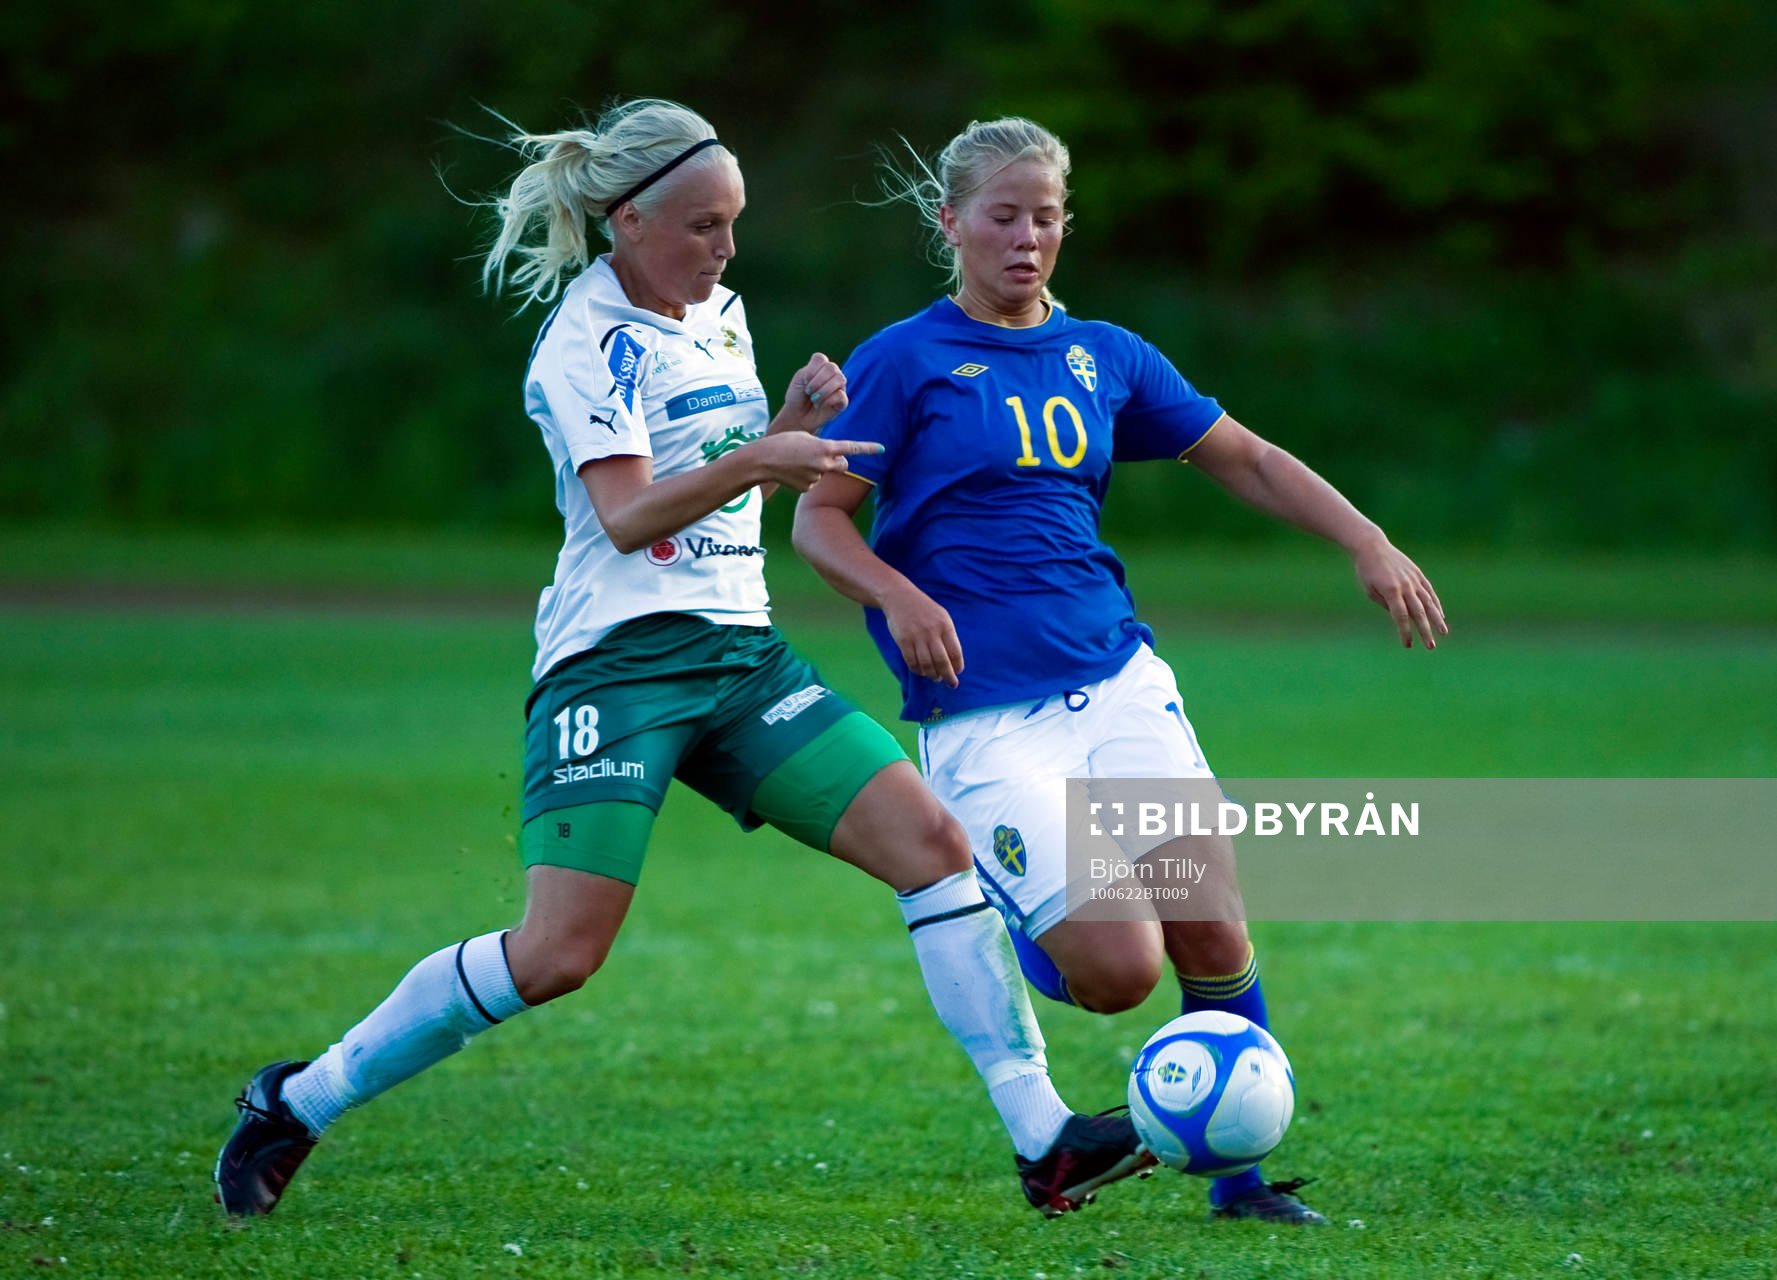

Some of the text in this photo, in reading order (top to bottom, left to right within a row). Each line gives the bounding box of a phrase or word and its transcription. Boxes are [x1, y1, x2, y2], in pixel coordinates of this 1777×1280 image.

[686, 391, 734, 410] Danica
[1005, 396, 1088, 468] 10
[553, 705, 599, 760] 18
[553, 758, 645, 784] stadium
[556, 822, 571, 838] 18
